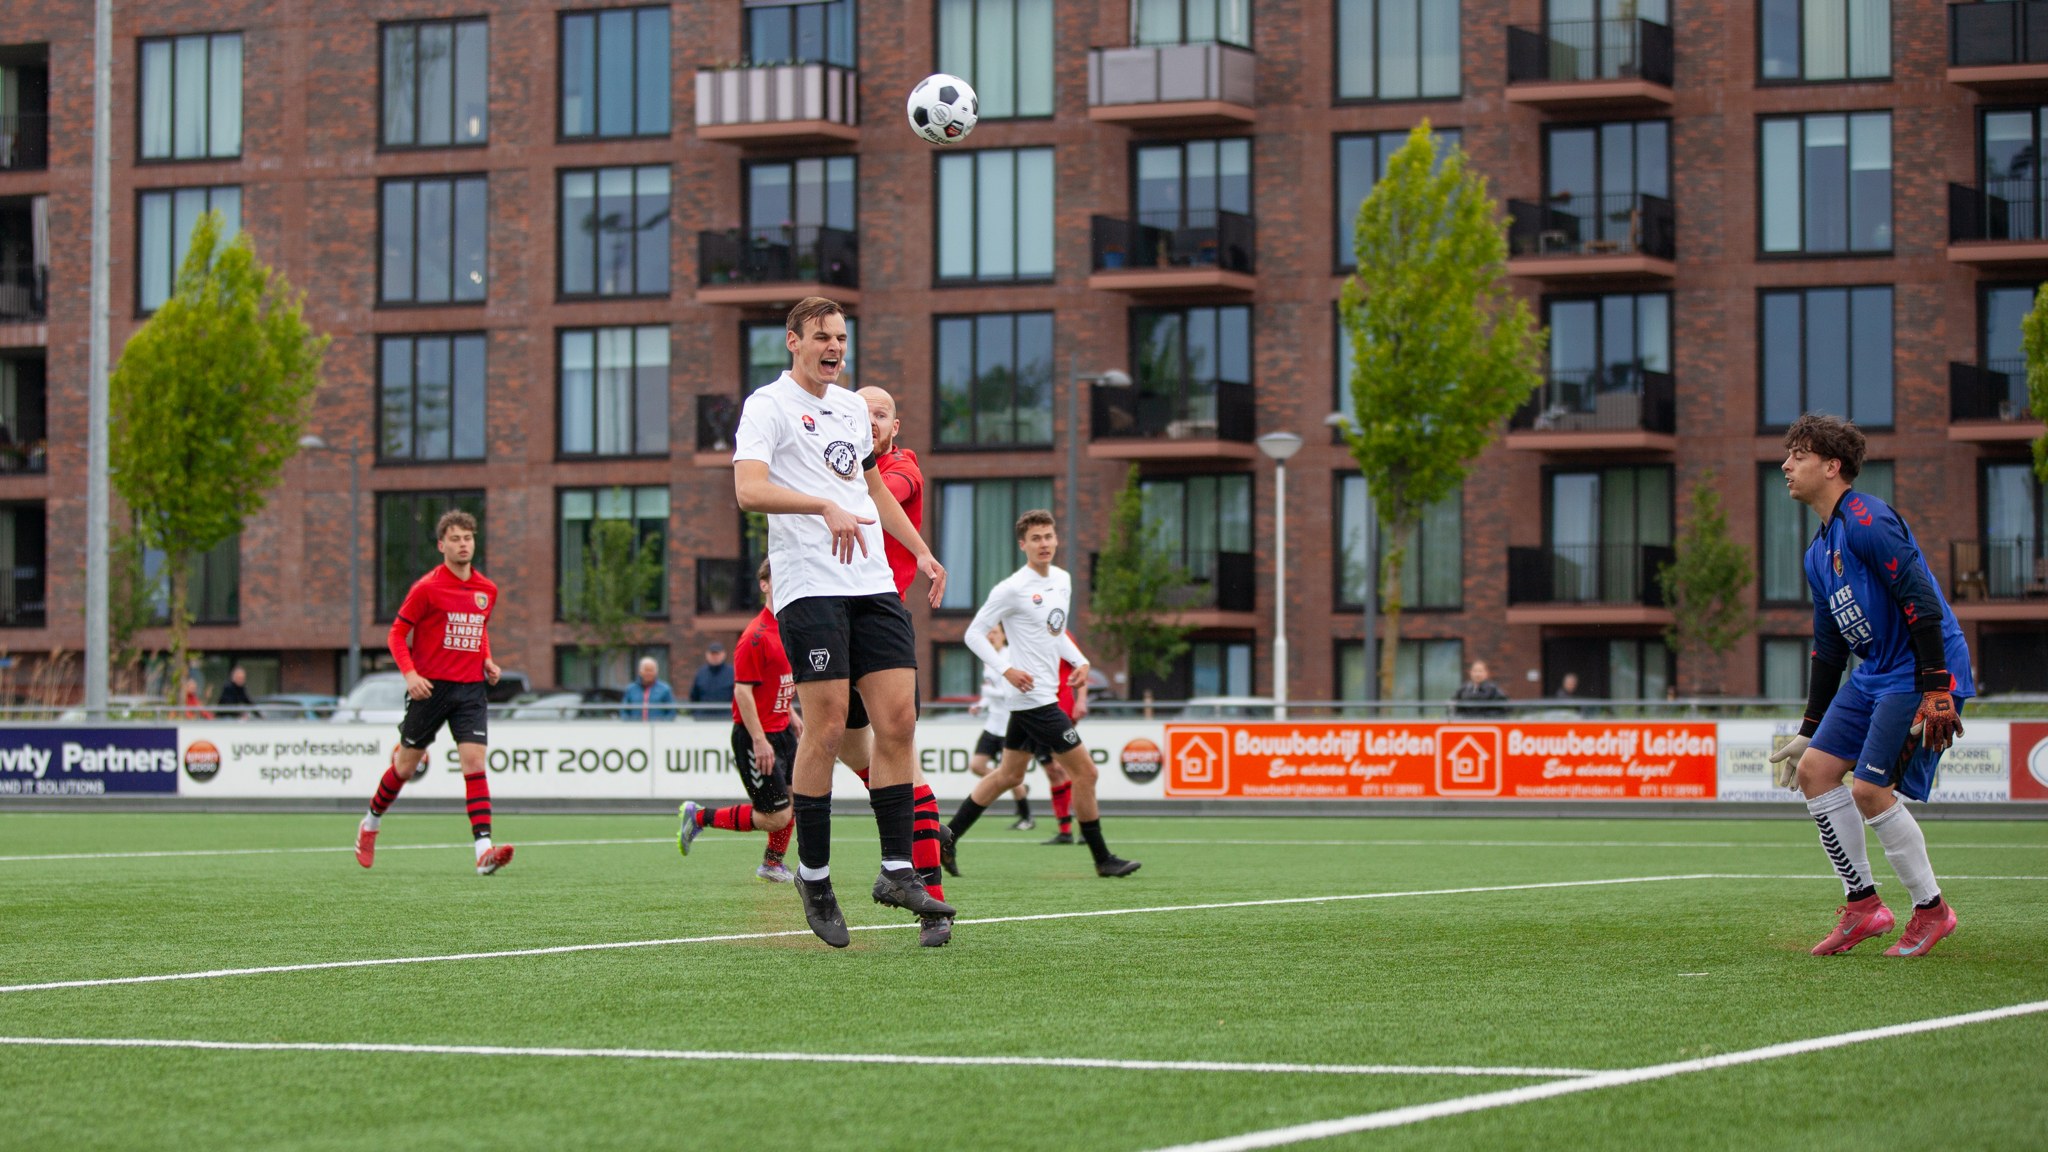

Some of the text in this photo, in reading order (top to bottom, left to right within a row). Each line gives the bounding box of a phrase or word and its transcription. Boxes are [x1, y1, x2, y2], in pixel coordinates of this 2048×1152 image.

[447, 612, 467, 623] VAN
[232, 738, 380, 761] your professional
[1235, 729, 1435, 762] Bouwbedrijf Leiden
[1507, 729, 1715, 762] Bouwbedrijf Leiden
[0, 742, 178, 778] vity Partners
[446, 748, 549, 773] SORT
[558, 748, 649, 773] 2000
[1123, 751, 1160, 763] SPORT
[1729, 749, 1767, 760] LUNCH
[1949, 749, 1991, 760] BORREL
[188, 763, 217, 773] 2000
[260, 763, 353, 783] sportshop
[1125, 763, 1158, 773] 2000
[1268, 758, 1297, 778] Een
[1543, 758, 1572, 778] Een
[1732, 763, 1764, 773] DINER
[1940, 763, 2001, 774] PROEVERIJ
[23, 780, 34, 794] IT
[36, 779, 105, 795] SOLUTIONS
[1931, 791, 2008, 801] OKAAL1574.NL
